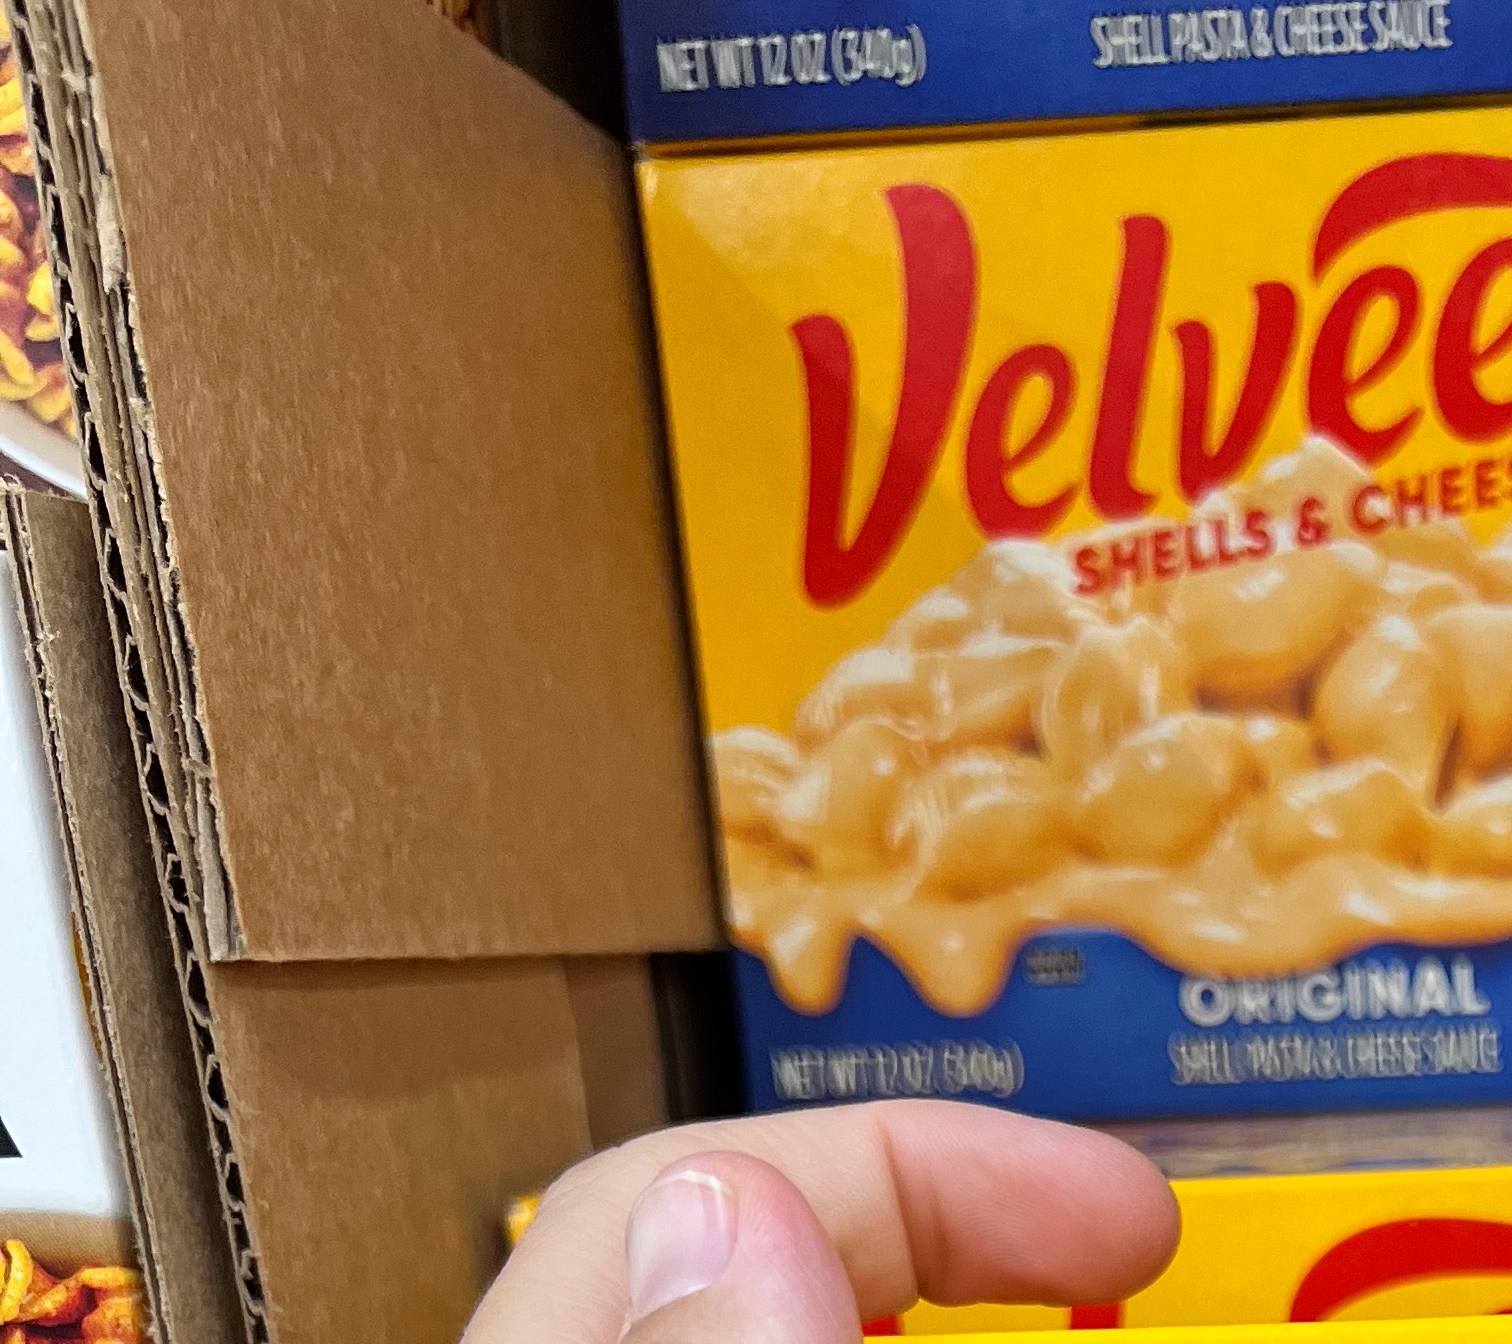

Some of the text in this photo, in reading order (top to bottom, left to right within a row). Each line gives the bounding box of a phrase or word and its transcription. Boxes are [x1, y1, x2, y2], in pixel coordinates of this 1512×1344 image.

[1074, 509, 1276, 596] SHELLS
[1297, 497, 1330, 550] &
[1178, 955, 1492, 1027] ORIGINAL
